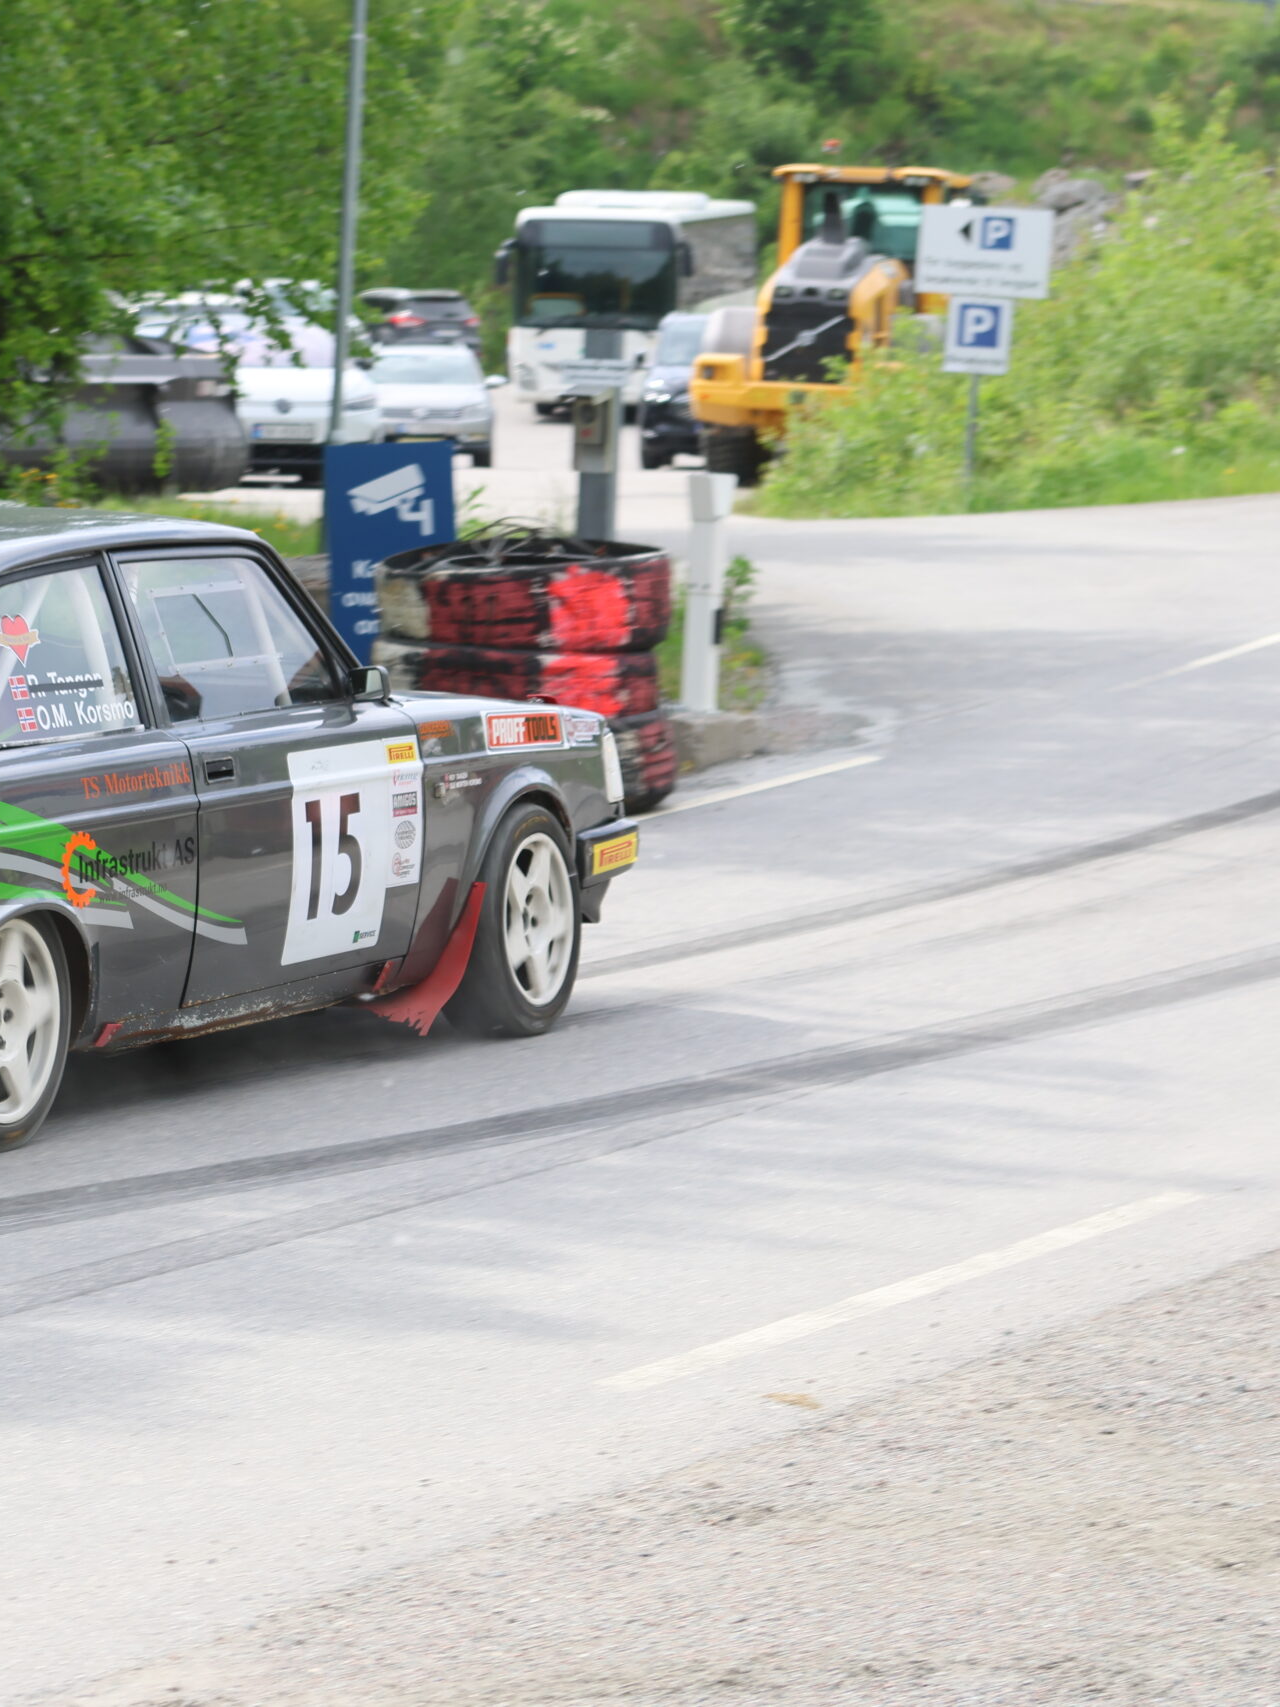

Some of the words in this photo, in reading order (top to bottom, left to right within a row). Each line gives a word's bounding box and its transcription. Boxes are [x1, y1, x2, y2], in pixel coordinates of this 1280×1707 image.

[984, 219, 1011, 248] P
[962, 307, 996, 345] P
[36, 702, 73, 731] O.M.
[74, 700, 135, 726] Korsmo
[388, 744, 416, 761] PIRELLI
[80, 775, 102, 800] TS
[103, 761, 192, 796] Motorteknikk
[172, 836, 195, 867] AS
[305, 792, 363, 921] 15
[599, 839, 633, 868] PIRELLI
